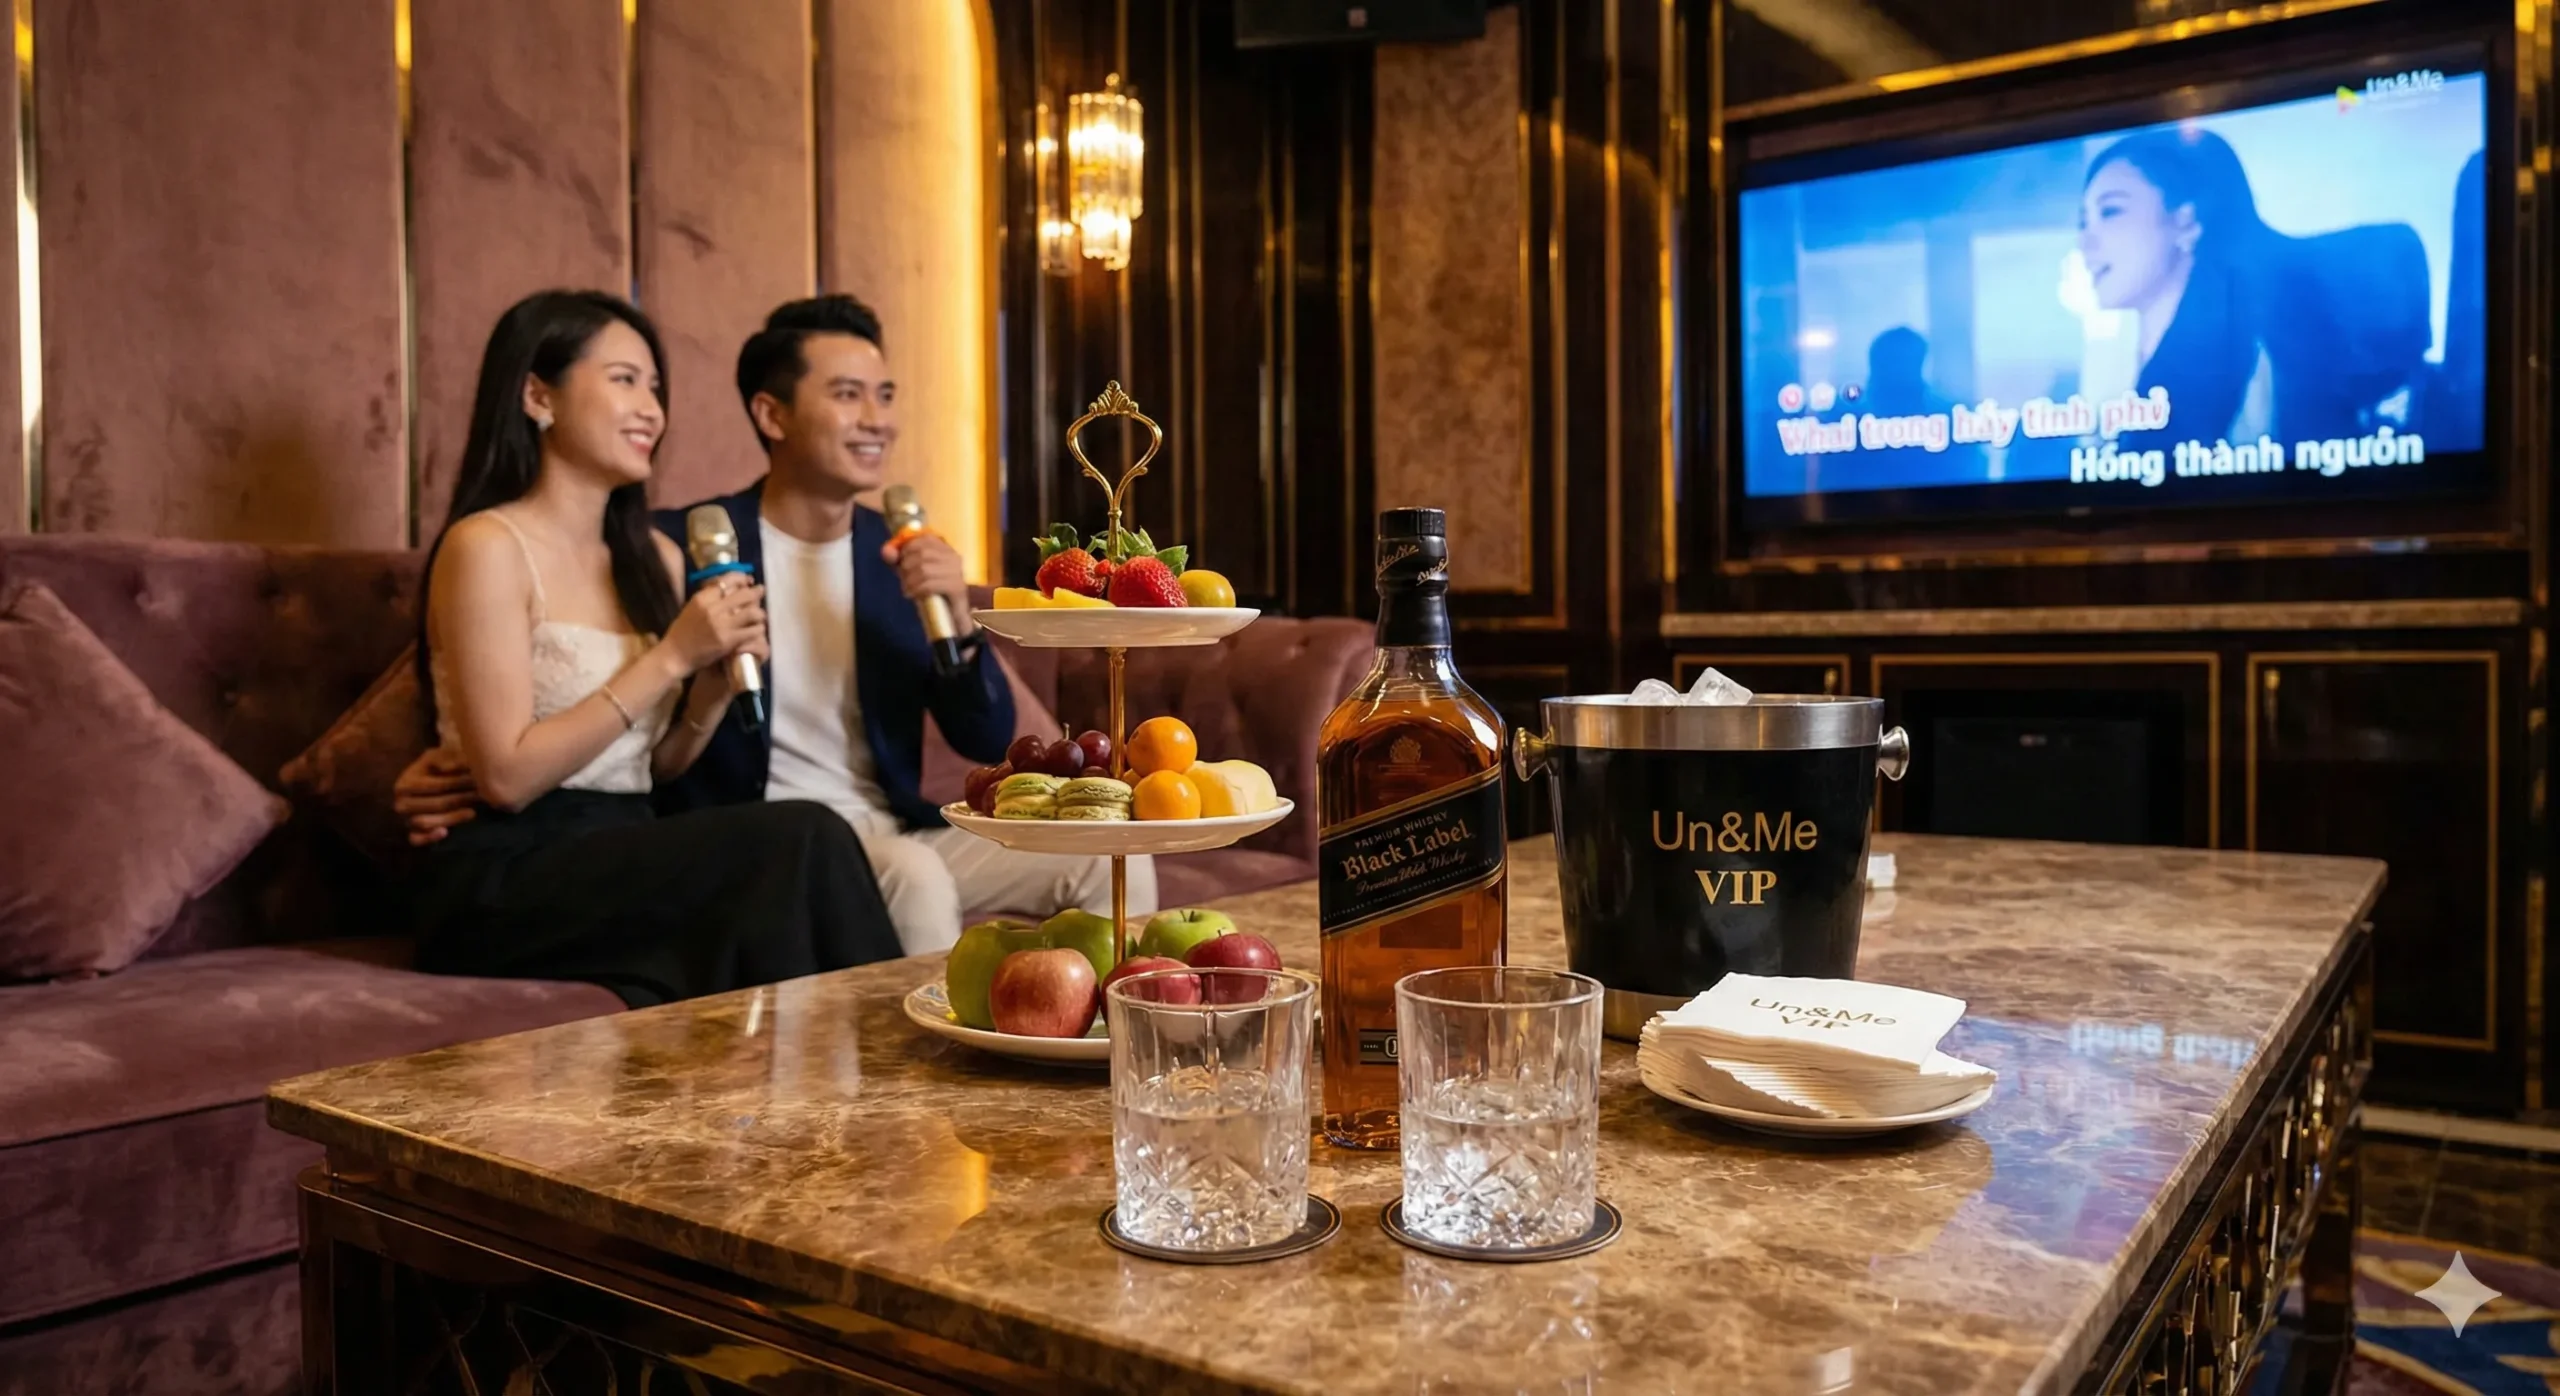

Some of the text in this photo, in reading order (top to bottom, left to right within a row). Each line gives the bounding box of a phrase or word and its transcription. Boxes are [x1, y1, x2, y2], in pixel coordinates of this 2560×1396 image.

[2173, 434, 2284, 477] thành
[1403, 810, 1448, 832] WHISKY
[1652, 810, 1818, 852] Un&Me
[1339, 843, 1407, 881] Black
[1405, 818, 1472, 858] Label
[1694, 869, 1777, 905] VIP
